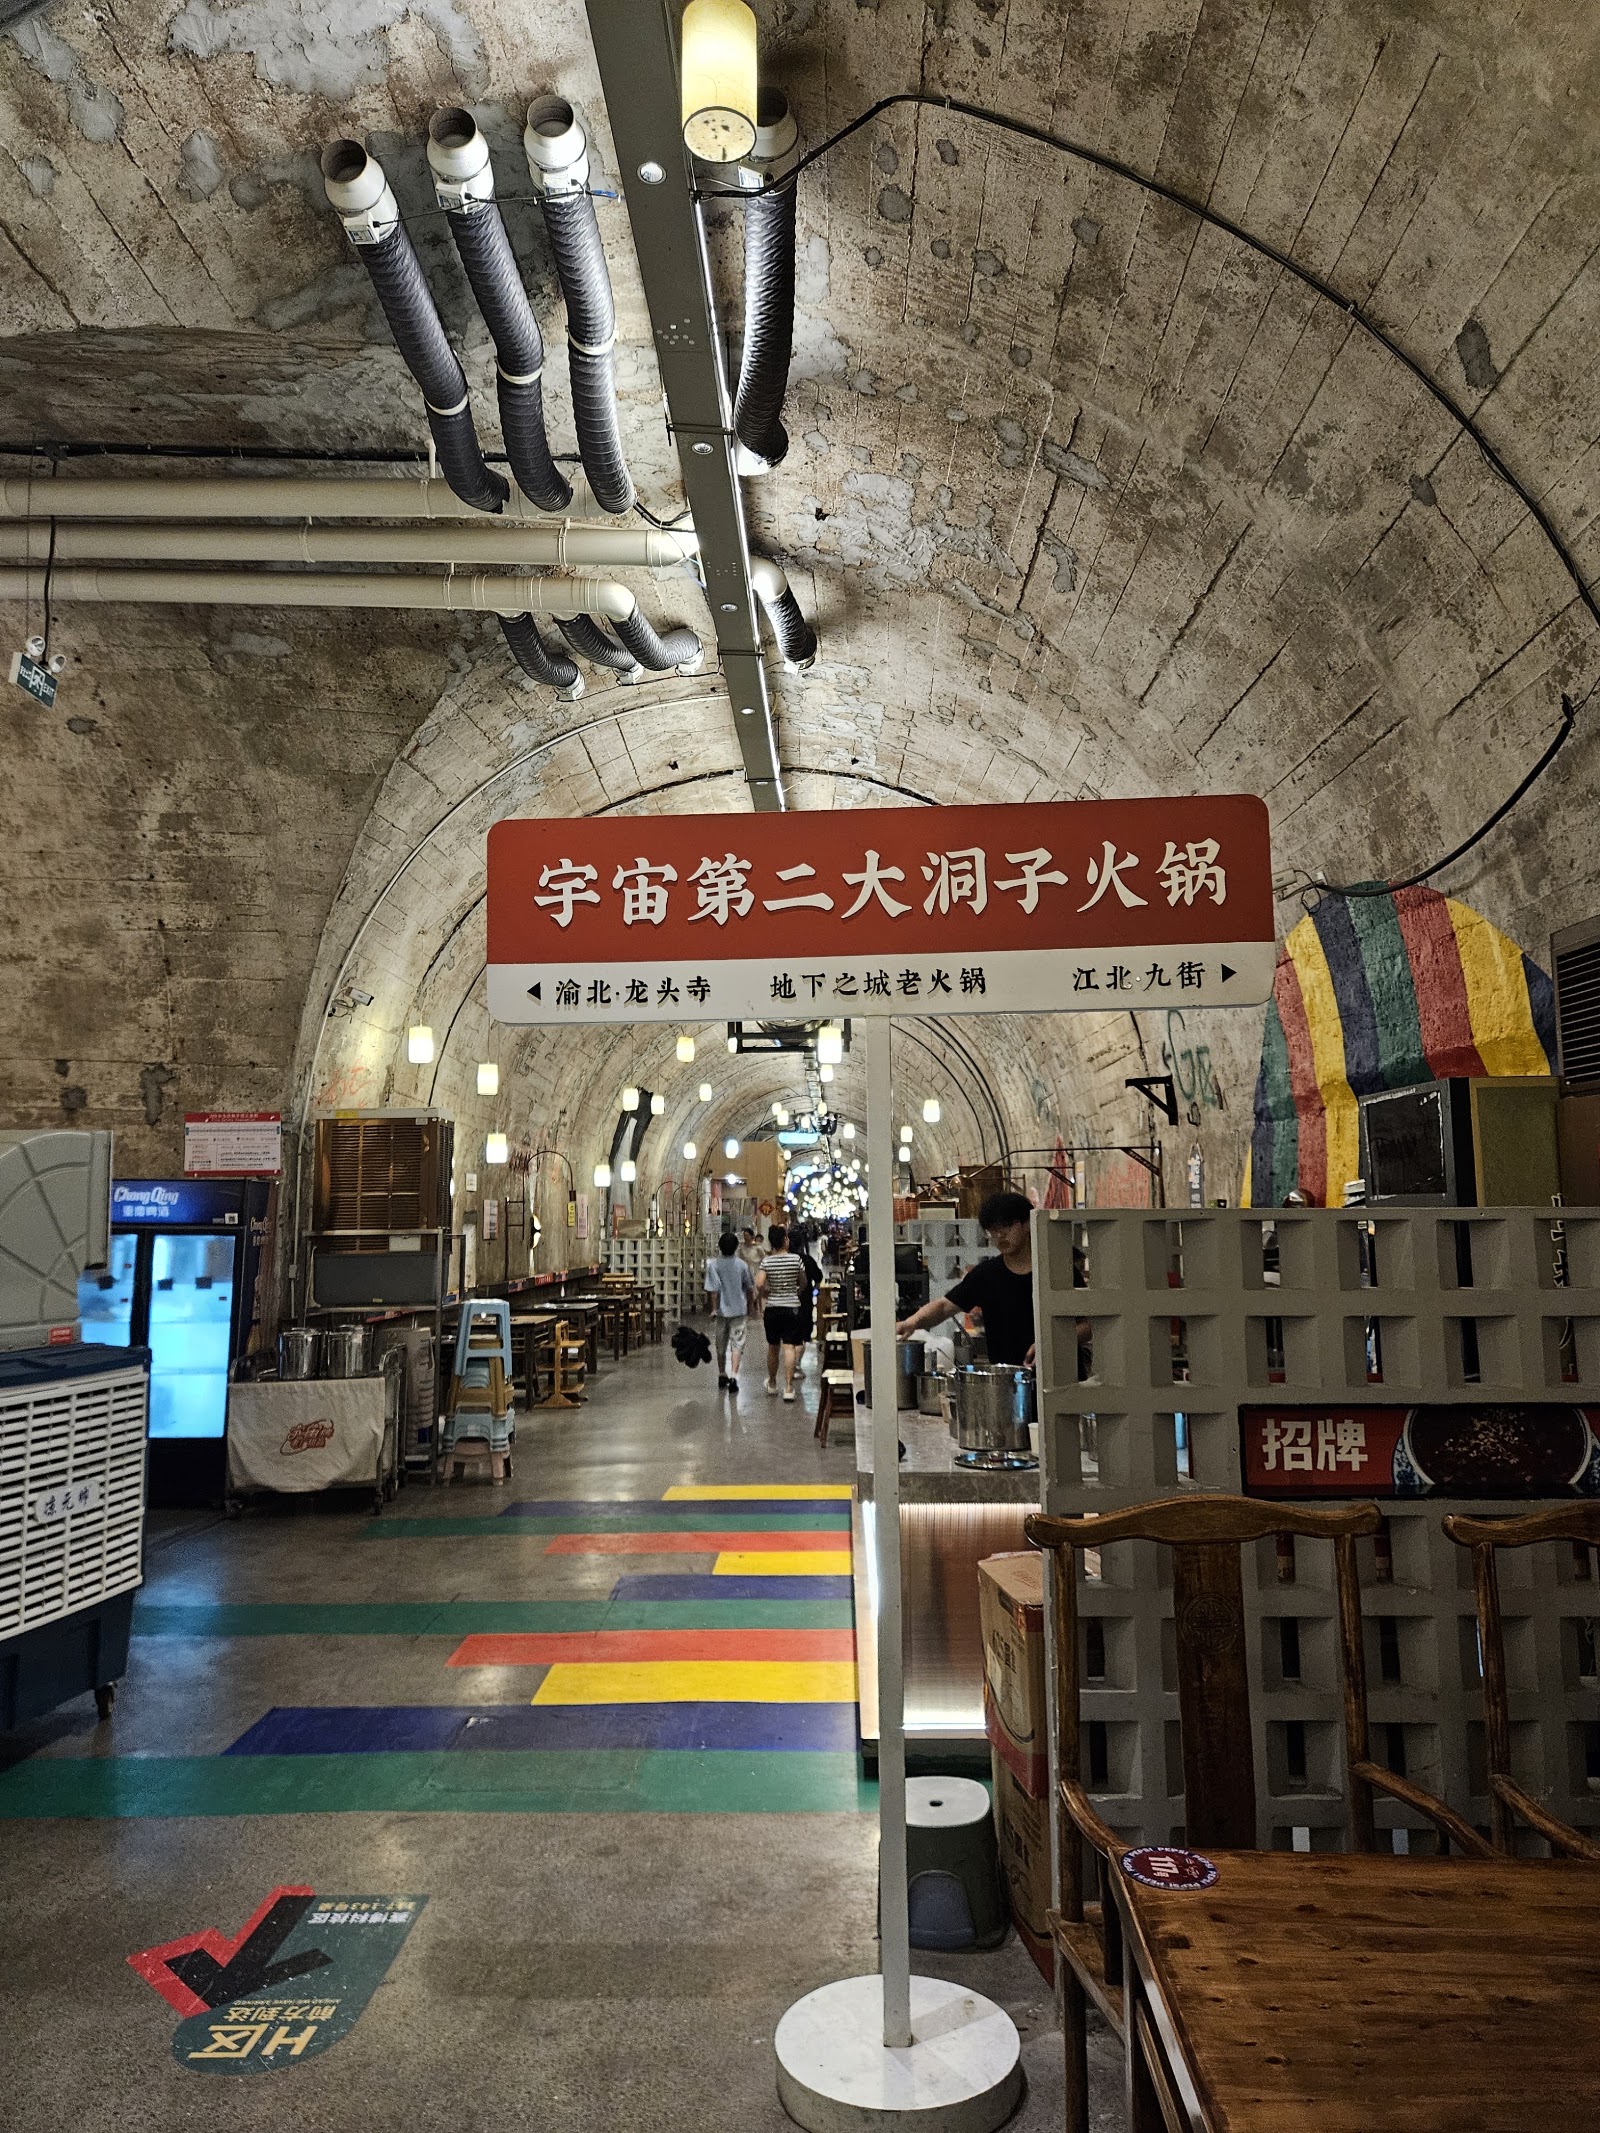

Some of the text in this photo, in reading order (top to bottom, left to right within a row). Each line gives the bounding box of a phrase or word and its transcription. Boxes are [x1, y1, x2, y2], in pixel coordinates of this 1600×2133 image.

[533, 837, 1227, 928] 宇宙第二大洞子火锅
[555, 976, 712, 1006] 渝北·龙头寺
[770, 966, 986, 1000] 地下之城老火锅
[1262, 1419, 1368, 1471] 招牌
[1157, 1847, 1189, 1855] PEPSI
[223, 2005, 337, 2022] 前方到达
[187, 2023, 318, 2059] H区
